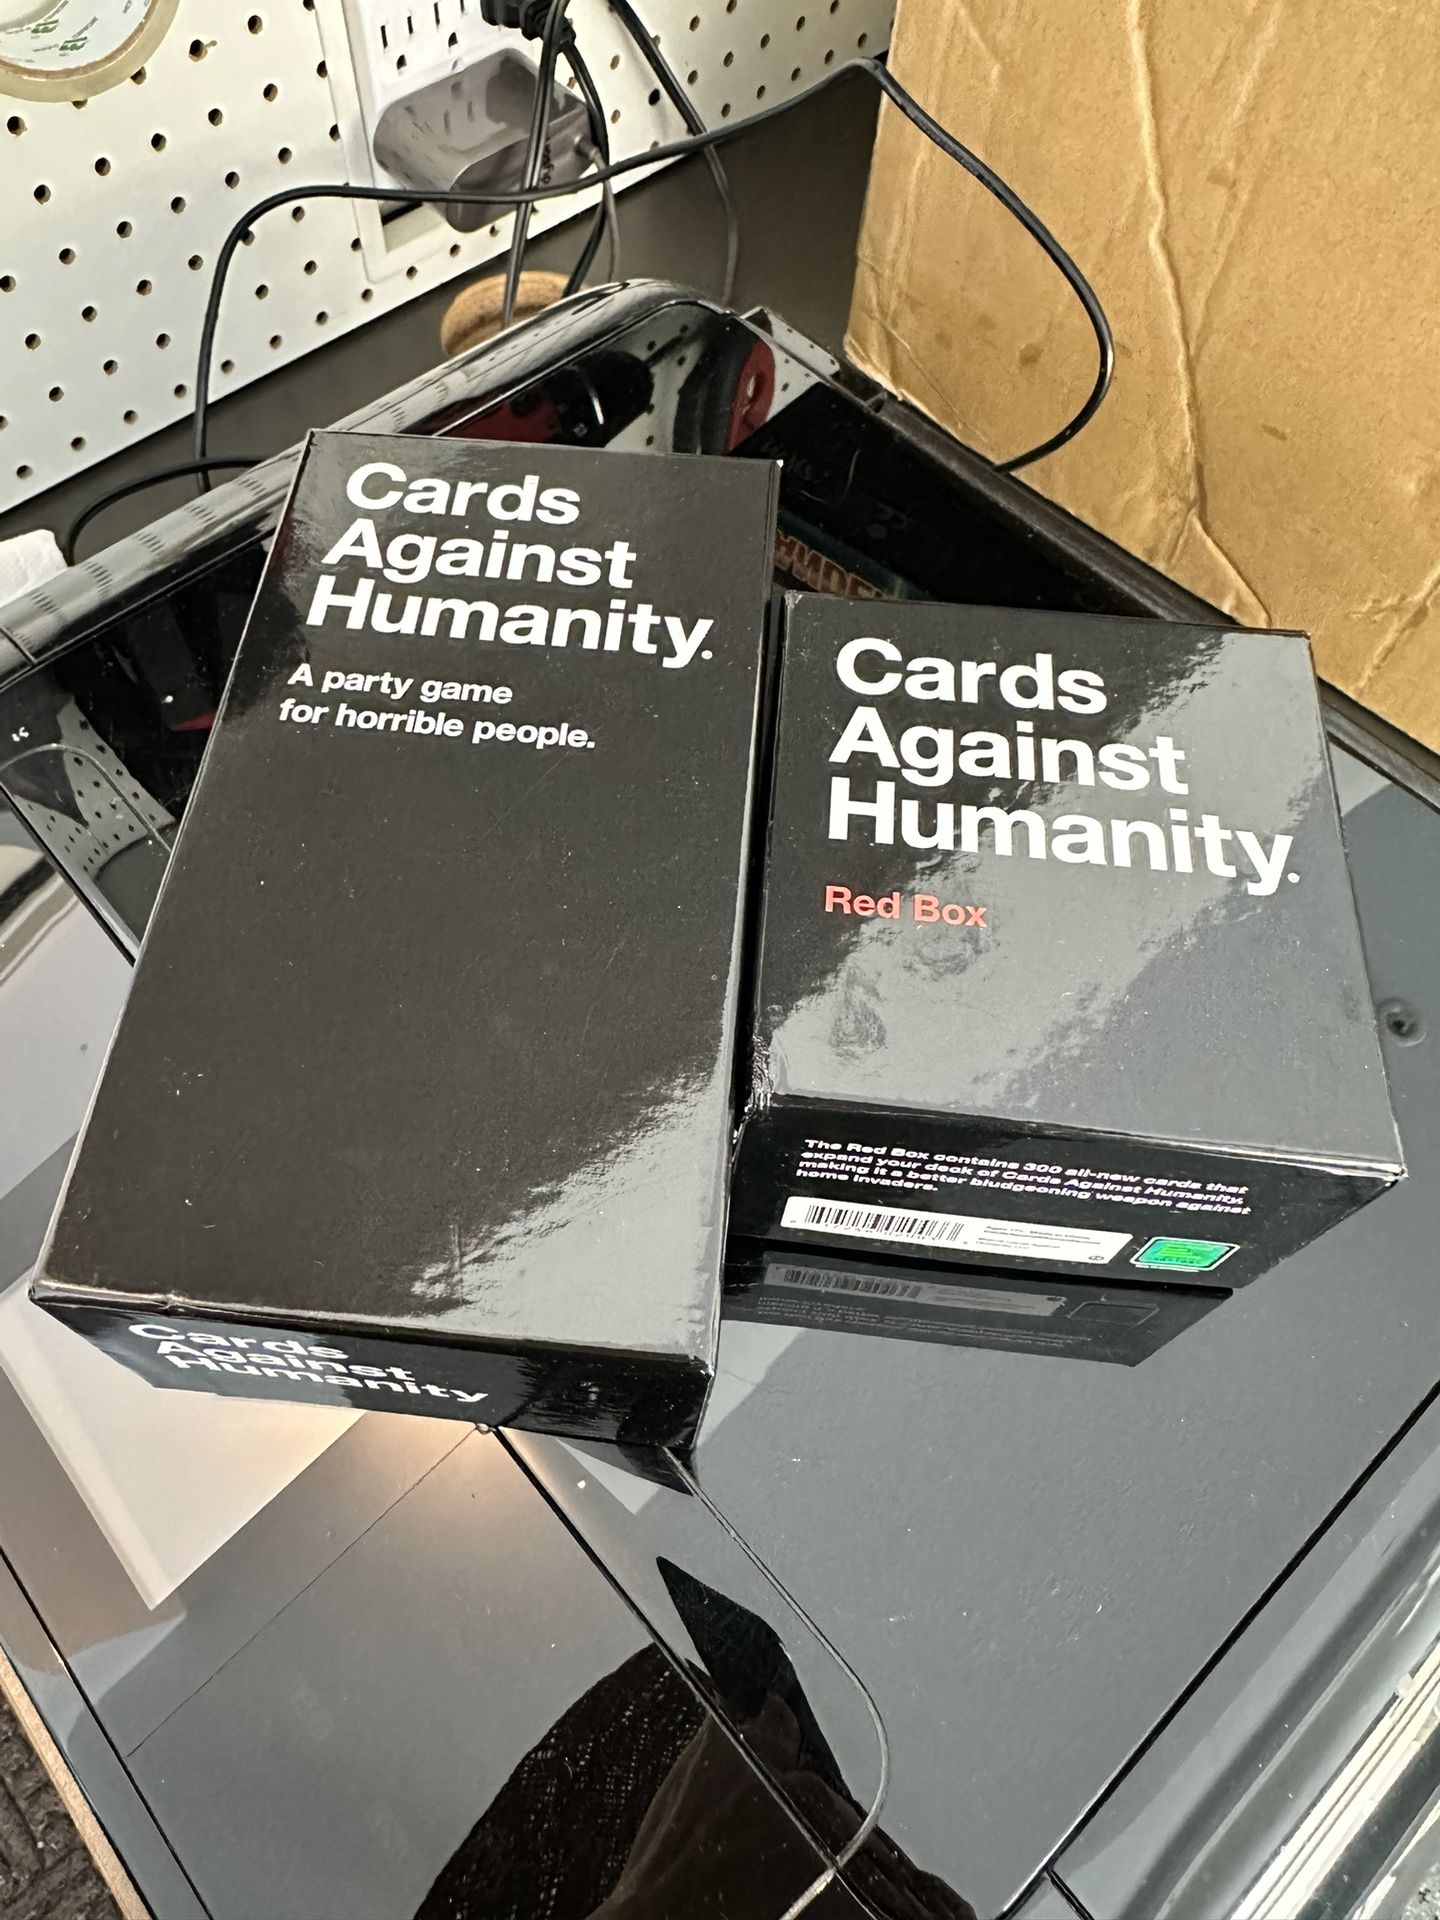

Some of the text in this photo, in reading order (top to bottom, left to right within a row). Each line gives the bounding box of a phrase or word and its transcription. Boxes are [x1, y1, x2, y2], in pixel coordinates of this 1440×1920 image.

[346, 462, 581, 525] Cards
[322, 518, 637, 589] Against
[305, 574, 714, 669] Humanity.
[287, 663, 513, 704] A party game
[835, 637, 1107, 714] Cards
[279, 698, 596, 750] for horrible people.
[828, 706, 1189, 795] Against
[827, 776, 1300, 897] Humanity.
[824, 885, 987, 928] Red Box
[796, 1169, 938, 1191] home invaders.
[799, 1161, 1251, 1215] making it a better bludgeoning weapon against
[801, 1152, 873, 1164] expand
[875, 1158, 922, 1170] your
[924, 1163, 974, 1176] deck
[977, 1169, 1000, 1178] of
[1002, 1171, 1062, 1185] Cards
[1064, 1178, 1142, 1194] Against
[804, 1139, 1249, 1194] The Red Box contains 300 all-new cards that
[128, 1324, 349, 1359] Cards
[157, 1341, 416, 1381] Against
[164, 1355, 488, 1402] Humanity
